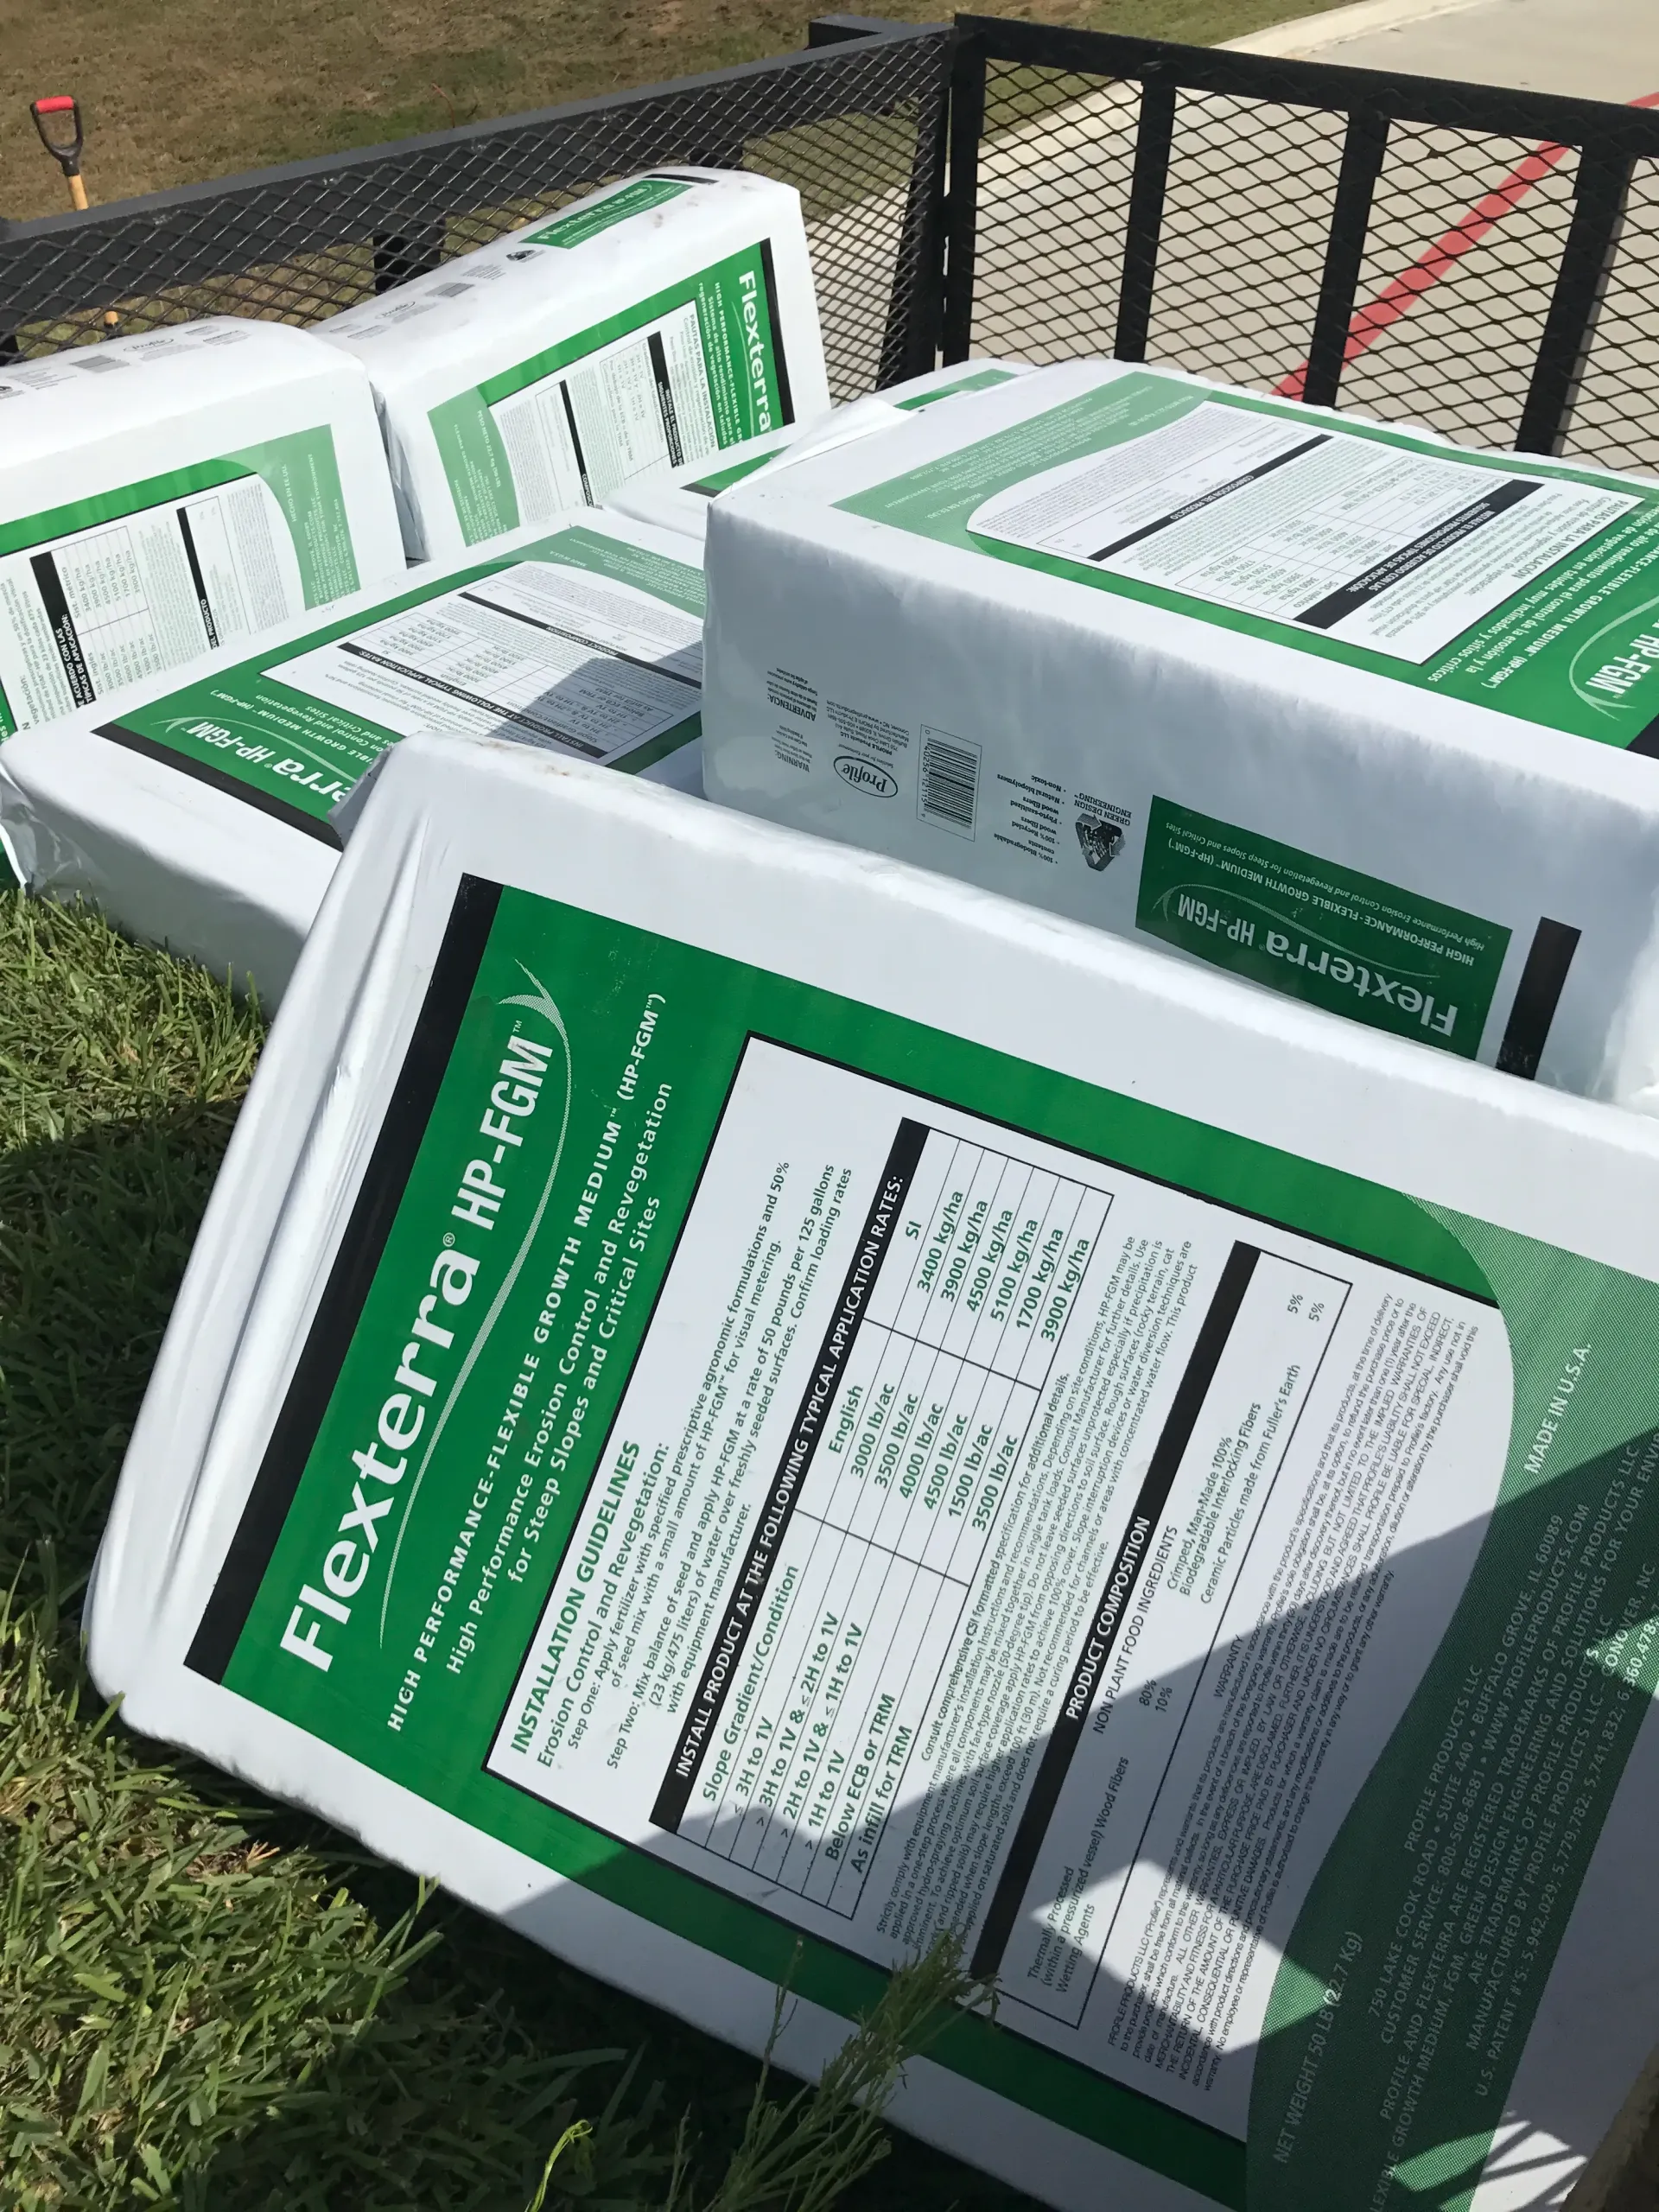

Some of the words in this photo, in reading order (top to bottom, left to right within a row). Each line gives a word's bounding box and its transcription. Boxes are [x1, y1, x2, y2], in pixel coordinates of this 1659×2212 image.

[664, 388, 674, 415] INSTALE
[669, 414, 675, 424] EL
[671, 423, 682, 458] PRODUCTO
[1593, 499, 1630, 521] PAUTAS
[1560, 533, 1580, 543] LA
[1572, 518, 1601, 535] PARA
[1620, 525, 1638, 535] de
[1510, 541, 1569, 579] INSTALACIÓN
[1582, 533, 1627, 563] vegetación
[1571, 561, 1587, 570] en
[1543, 569, 1579, 591] taludes
[1524, 589, 1549, 605] muy
[1486, 602, 1535, 635] inclinados
[54, 627, 66, 644] LAS
[60, 613, 81, 662] APLICACIÓN:
[60, 643, 71, 662] CON
[1457, 639, 1485, 658] sitios
[66, 662, 83, 699] ACUERDO
[75, 662, 85, 674] DE
[1427, 657, 1463, 683] críticos
[79, 673, 93, 703] TÍPICAS
[255, 694, 315, 722] Revegetation
[304, 705, 329, 719] Sites
[766, 693, 817, 721] ADVERTENCIA:
[312, 719, 334, 730] and
[326, 715, 362, 733] Critical
[359, 730, 383, 741] and
[301, 728, 347, 751] GROWTH
[331, 728, 370, 747] Control
[774, 749, 810, 773] WARNING:
[996, 773, 1036, 795] biopolymers
[1030, 774, 1062, 792] Non-toxic
[1021, 796, 1041, 809] fibers
[1034, 788, 1060, 804] Natural
[1073, 798, 1103, 817] DESIGN
[1009, 799, 1058, 824] Phyto-sanitized
[1040, 803, 1059, 816] wood
[1103, 810, 1131, 826] GREEN
[1011, 820, 1039, 837] Recycled
[1020, 816, 1039, 829] fibers
[1039, 823, 1057, 836] wood
[1165, 822, 1182, 835] Sites
[993, 832, 1037, 856] Biodegradable
[1027, 839, 1055, 855] contents
[1039, 832, 1055, 844] 100%
[1181, 830, 1206, 845] Critical
[1205, 839, 1222, 849] and
[1038, 851, 1053, 863] 100%
[1222, 844, 1248, 861] Slopes
[1247, 853, 1269, 868] Steep
[1268, 863, 1282, 874] for
[1282, 868, 1334, 893] Revegetation
[1264, 876, 1310, 902] GROWTH
[1332, 887, 1351, 898] and
[1349, 893, 1381, 911] Control
[1381, 905, 1412, 924] Erosion
[1411, 917, 1464, 944] Performance
[1445, 947, 1475, 966] HIGH
[1464, 937, 1484, 951] High
[769, 1161, 790, 1192] 50%
[761, 1193, 779, 1223] and
[905, 1220, 922, 1241] SI
[916, 1247, 943, 1294] 3400
[932, 1191, 963, 1244] kg/ha
[939, 1256, 967, 1303] 3900
[957, 1200, 988, 1255] kg/ha
[966, 1266, 992, 1313] 4500
[981, 1210, 1014, 1264] kg/ha
[726, 1224, 767, 1313] formulations
[702, 1315, 735, 1391] agronomic
[446, 1621, 478, 1674] High
[467, 1473, 533, 1616] Performance
[524, 1382, 568, 1467] Erosion
[558, 1288, 601, 1375] Control
[594, 1239, 618, 1285] and
[607, 1083, 672, 1235] Revegetation
[1556, 1343, 1592, 1394] U.S.A.
[506, 1547, 532, 1583] for
[523, 1478, 561, 1543] Steep
[550, 1395, 589, 1471] Slopes
[582, 1344, 607, 1390] and
[598, 1256, 639, 1339] Critical
[628, 1196, 660, 1252] Sites
[1547, 1395, 1568, 1417] IN
[827, 1385, 863, 1454] English
[849, 1432, 876, 1478] 3000
[866, 1382, 895, 1430] lb/ac
[671, 1393, 708, 1477] prescriptive
[874, 1442, 900, 1489] 3500
[890, 1393, 918, 1440] lb/ac
[1523, 1417, 1559, 1474] MADE
[899, 1452, 925, 1499] 4000
[913, 1402, 944, 1450] lb/ac
[386, 1669, 421, 1732] HIGH
[413, 1352, 540, 1663] PERFORMANCE-FLEXIBLE
[533, 1236, 582, 1344] GROWTH
[675, 1707, 712, 1777] INSTALL
[702, 1616, 743, 1704] PRODUCT
[735, 1587, 753, 1617] AT
[744, 1549, 768, 1585] THE
[759, 1438, 809, 1548] FOLLOWING
[798, 1363, 837, 1433] TYPICAL
[829, 1240, 880, 1360] APPLICATION
[870, 1175, 903, 1238] RATES:
[647, 1475, 677, 1541] specified
[633, 1541, 653, 1574] with
[510, 1586, 586, 1754] INSTALLATION
[575, 1440, 639, 1583] GUIDELINES
[536, 1697, 575, 1768] Erosion
[565, 1619, 603, 1693] Control
[595, 1578, 618, 1619] and
[607, 1442, 670, 1578] Revegetation:
[608, 1575, 639, 1637] fertilizer
[1065, 1637, 1104, 1719] PRODUCT
[1096, 1516, 1150, 1637] COMPOSITION
[594, 1637, 619, 1681] Apply
[702, 1749, 732, 1802] Slope
[722, 1565, 799, 1745] Gradient/Condition
[580, 1681, 601, 1715] One:
[868, 1693, 896, 1735] TRM
[567, 1717, 588, 1750] Step
[885, 1725, 912, 1767] TRM
[863, 1738, 878, 1762] or
[845, 1763, 870, 1801] ECB
[874, 1770, 896, 1800] for
[824, 1802, 855, 1860] Below
[858, 1801, 885, 1846] infill
[850, 1848, 868, 1873] As
[1338, 1930, 1363, 1963] Kg)
[1318, 1962, 1349, 2007] (22.7
[1314, 2009, 1335, 2032] LB
[1306, 2032, 1327, 2056] 50
[1284, 2055, 1319, 2126] WEIGHT
[1272, 2126, 1295, 2164] NET
